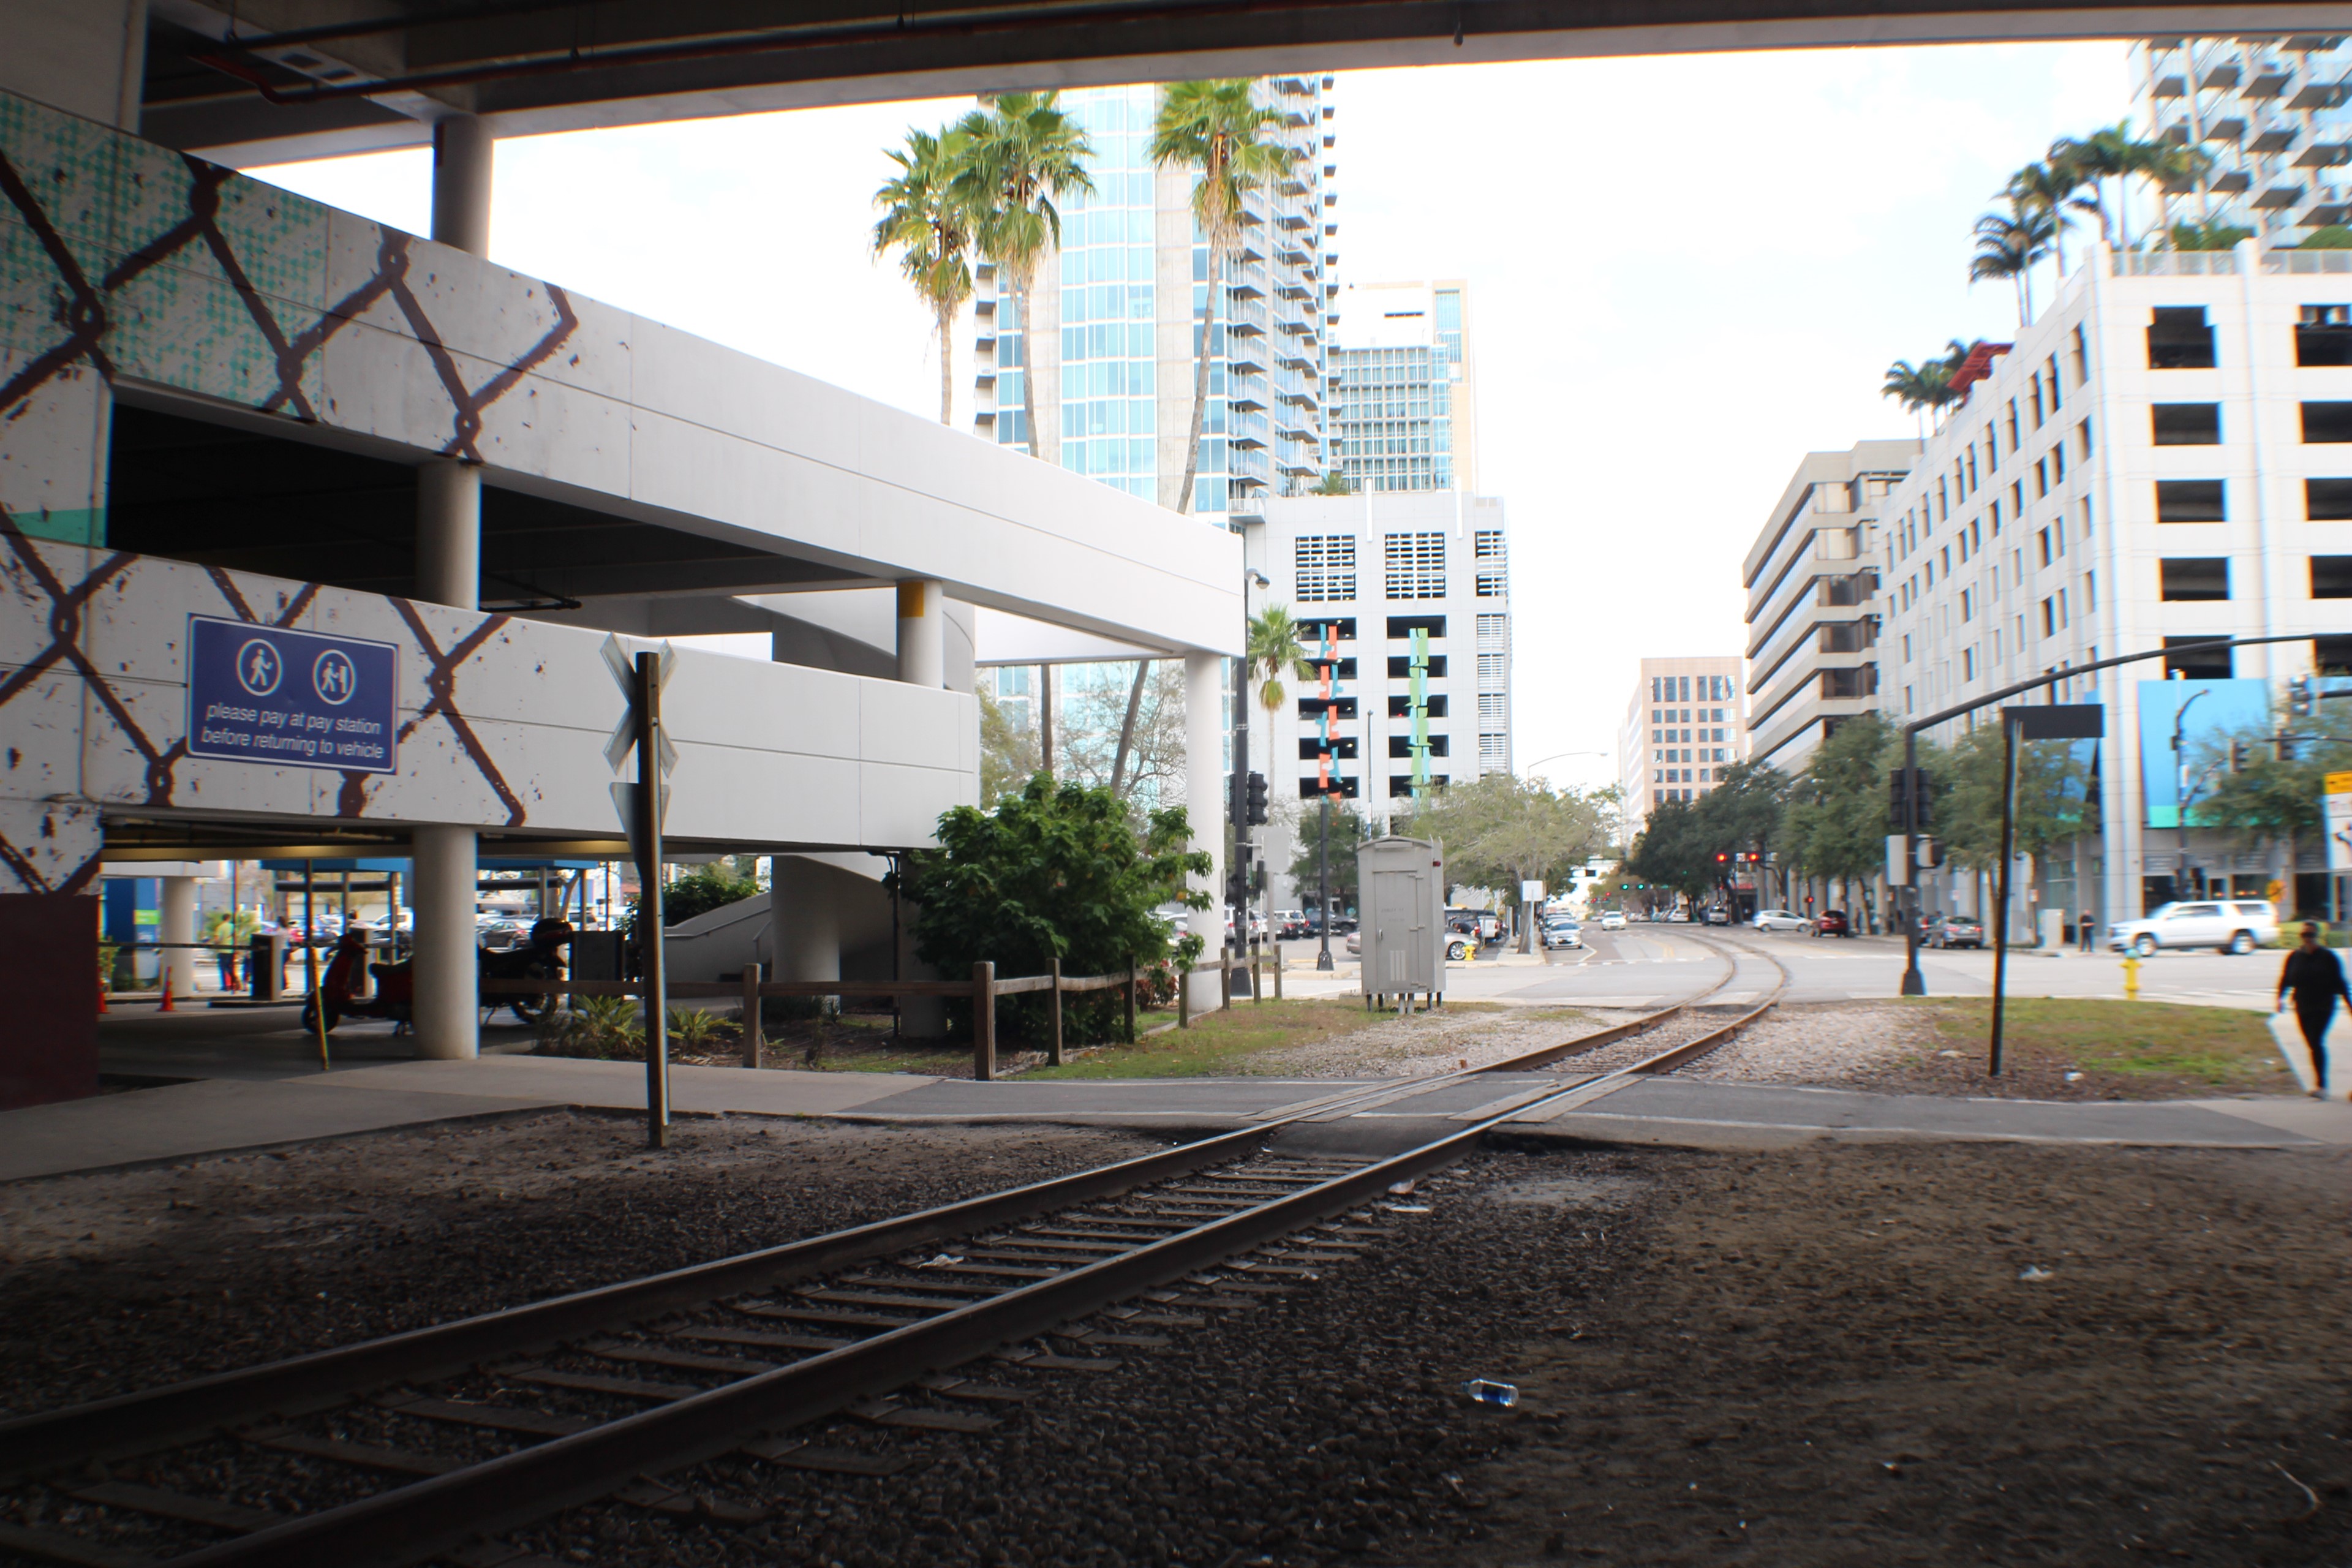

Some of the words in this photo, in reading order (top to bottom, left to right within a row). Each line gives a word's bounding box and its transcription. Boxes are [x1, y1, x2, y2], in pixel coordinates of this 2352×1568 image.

[205, 702, 257, 722] please
[258, 710, 288, 729] pay
[289, 712, 305, 727] at
[306, 715, 334, 734] pay
[335, 717, 382, 734] station
[201, 726, 251, 747] before
[252, 734, 317, 756] returning
[319, 739, 333, 754] to
[337, 741, 385, 759] vehicle
